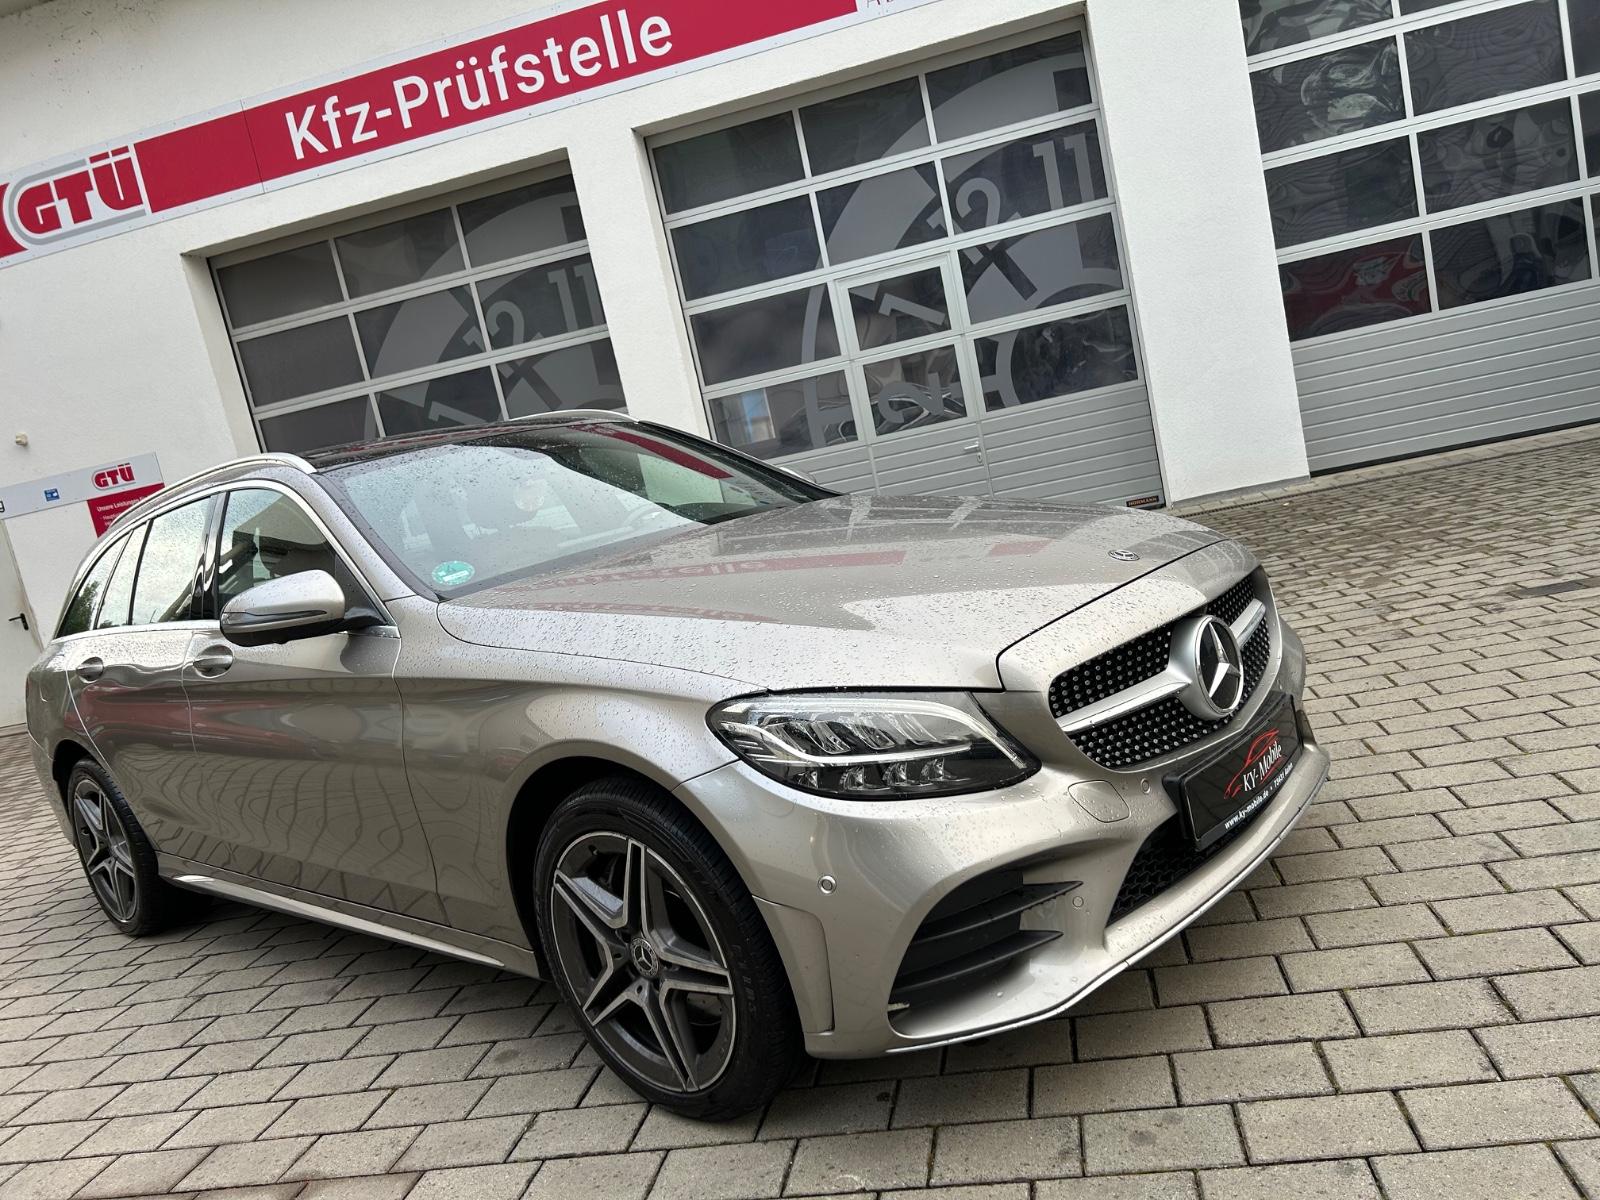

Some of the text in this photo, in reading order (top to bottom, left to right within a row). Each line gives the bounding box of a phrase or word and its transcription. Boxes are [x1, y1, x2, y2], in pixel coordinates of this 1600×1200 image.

[285, 8, 673, 161] Kfz-Prüfstelle
[17, 145, 144, 235] GTÜ
[94, 462, 136, 488] GTÜ
[1224, 789, 1269, 830] www.ky-mobile.de
